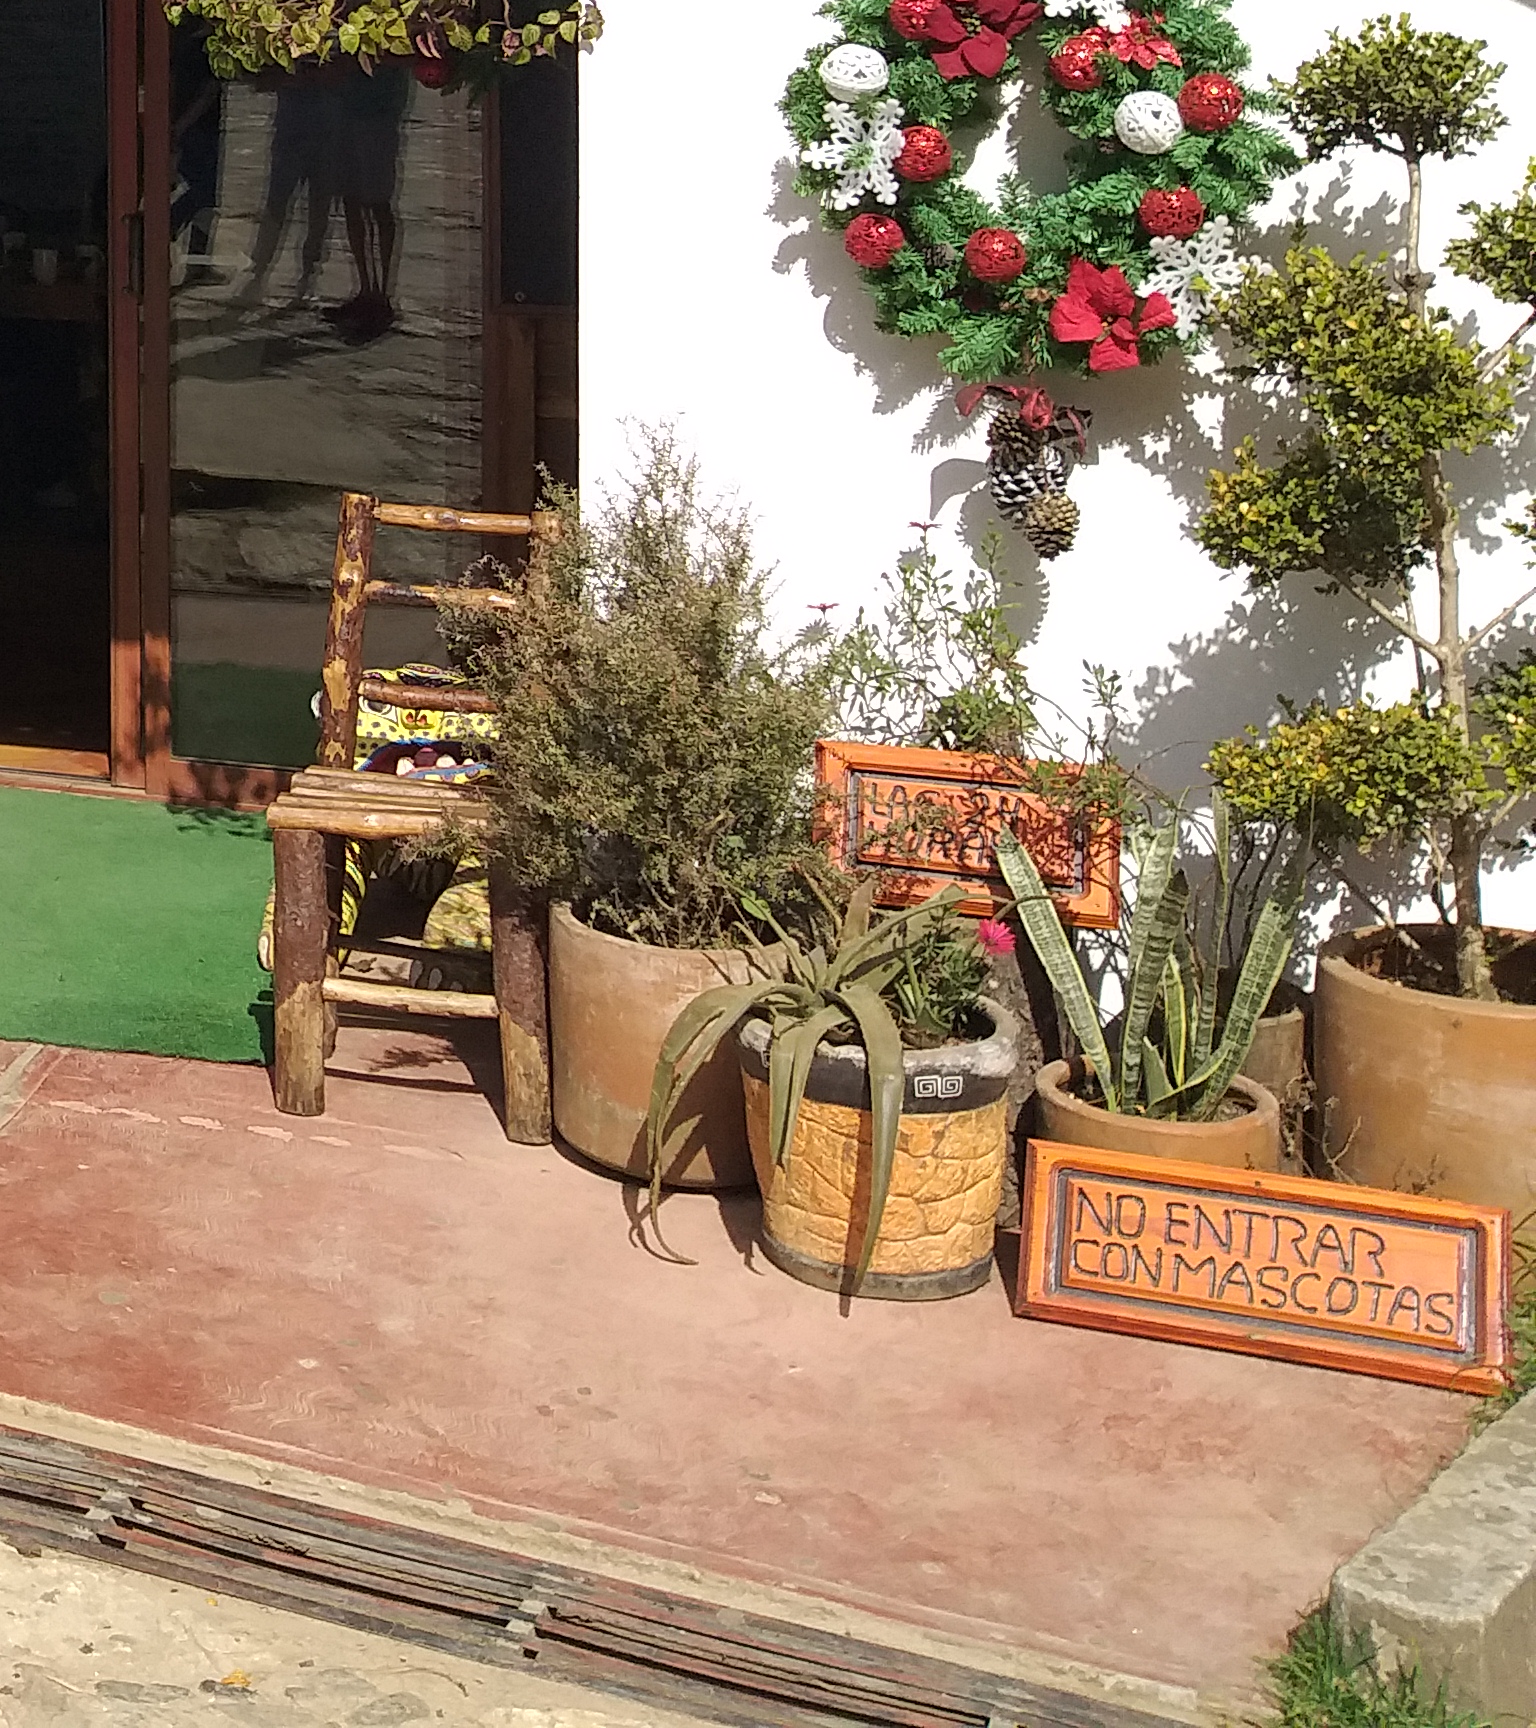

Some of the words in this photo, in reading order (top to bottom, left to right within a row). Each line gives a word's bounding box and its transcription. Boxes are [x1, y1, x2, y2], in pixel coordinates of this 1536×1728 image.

[1074, 1186, 1147, 1240] NO
[1164, 1201, 1387, 1279] ENTRAR
[1071, 1238, 1164, 1289] CON
[1172, 1253, 1456, 1336] MASCOTAS
